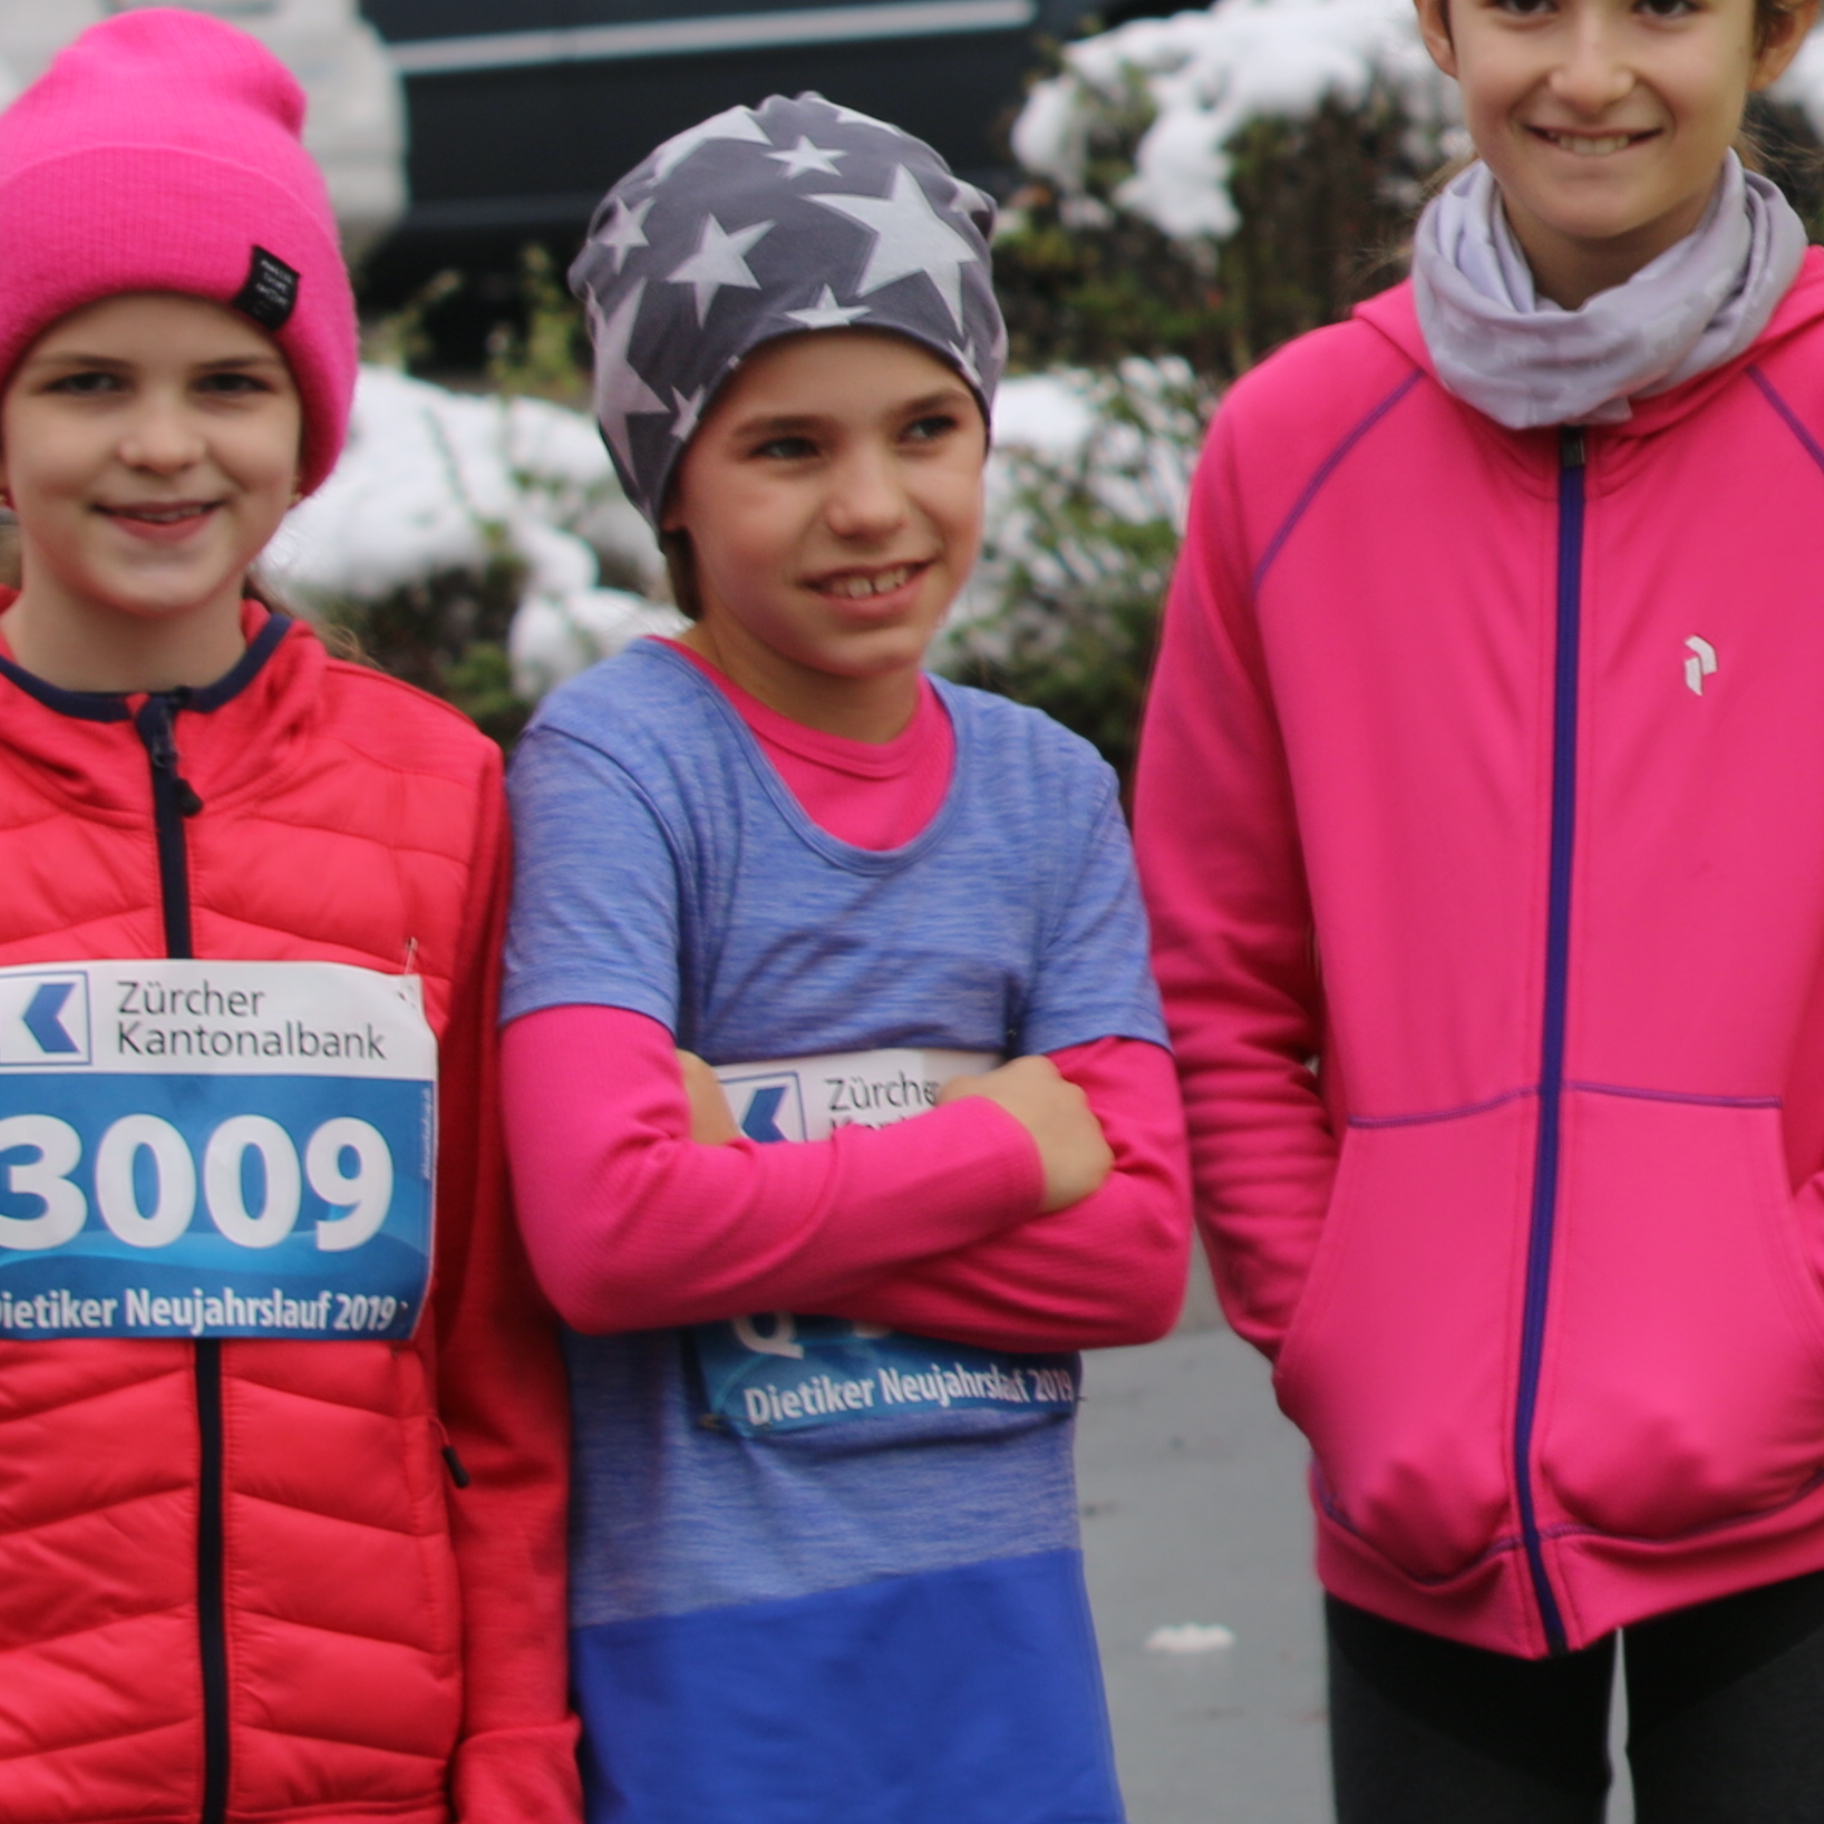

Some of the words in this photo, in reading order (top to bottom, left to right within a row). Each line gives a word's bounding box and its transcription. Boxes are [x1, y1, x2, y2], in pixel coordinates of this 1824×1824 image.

[117, 980, 266, 1018] Zürcher
[117, 1020, 387, 1060] Kantonalbank
[824, 1068, 942, 1111] Zürche
[0, 1114, 394, 1251] 3009
[0, 1289, 118, 1329] ietiker
[125, 1287, 331, 1336] Neujahrslauf
[334, 1293, 397, 1331] 2019
[744, 1375, 876, 1426] Dietiker
[1028, 1369, 1075, 1402] 2019
